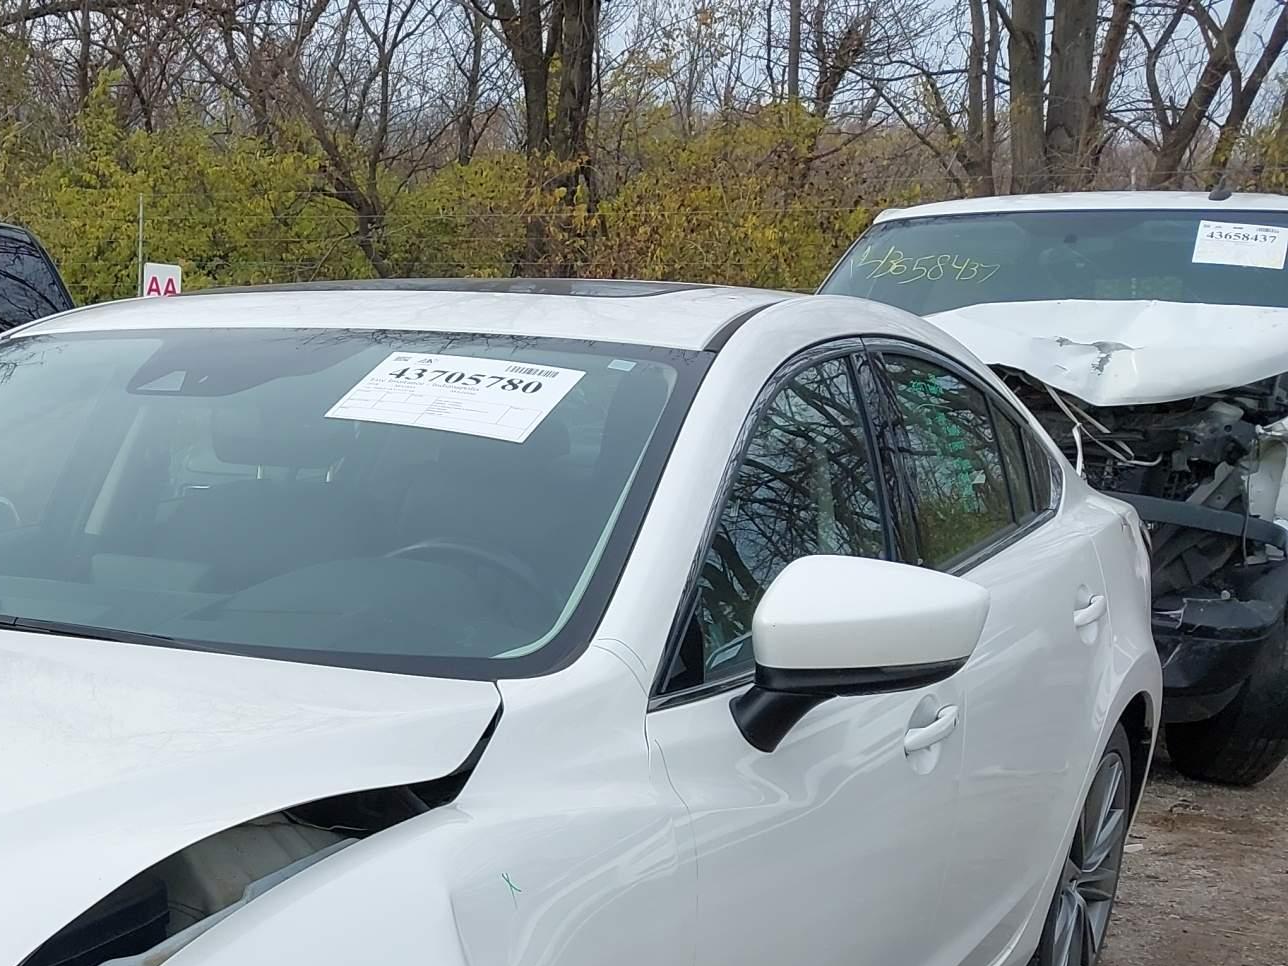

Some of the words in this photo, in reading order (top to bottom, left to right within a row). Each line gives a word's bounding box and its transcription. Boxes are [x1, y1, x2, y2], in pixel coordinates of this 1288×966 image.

[1206, 231, 1278, 244] 43658437
[147, 276, 177, 295] AA
[389, 366, 543, 395] 43705780
